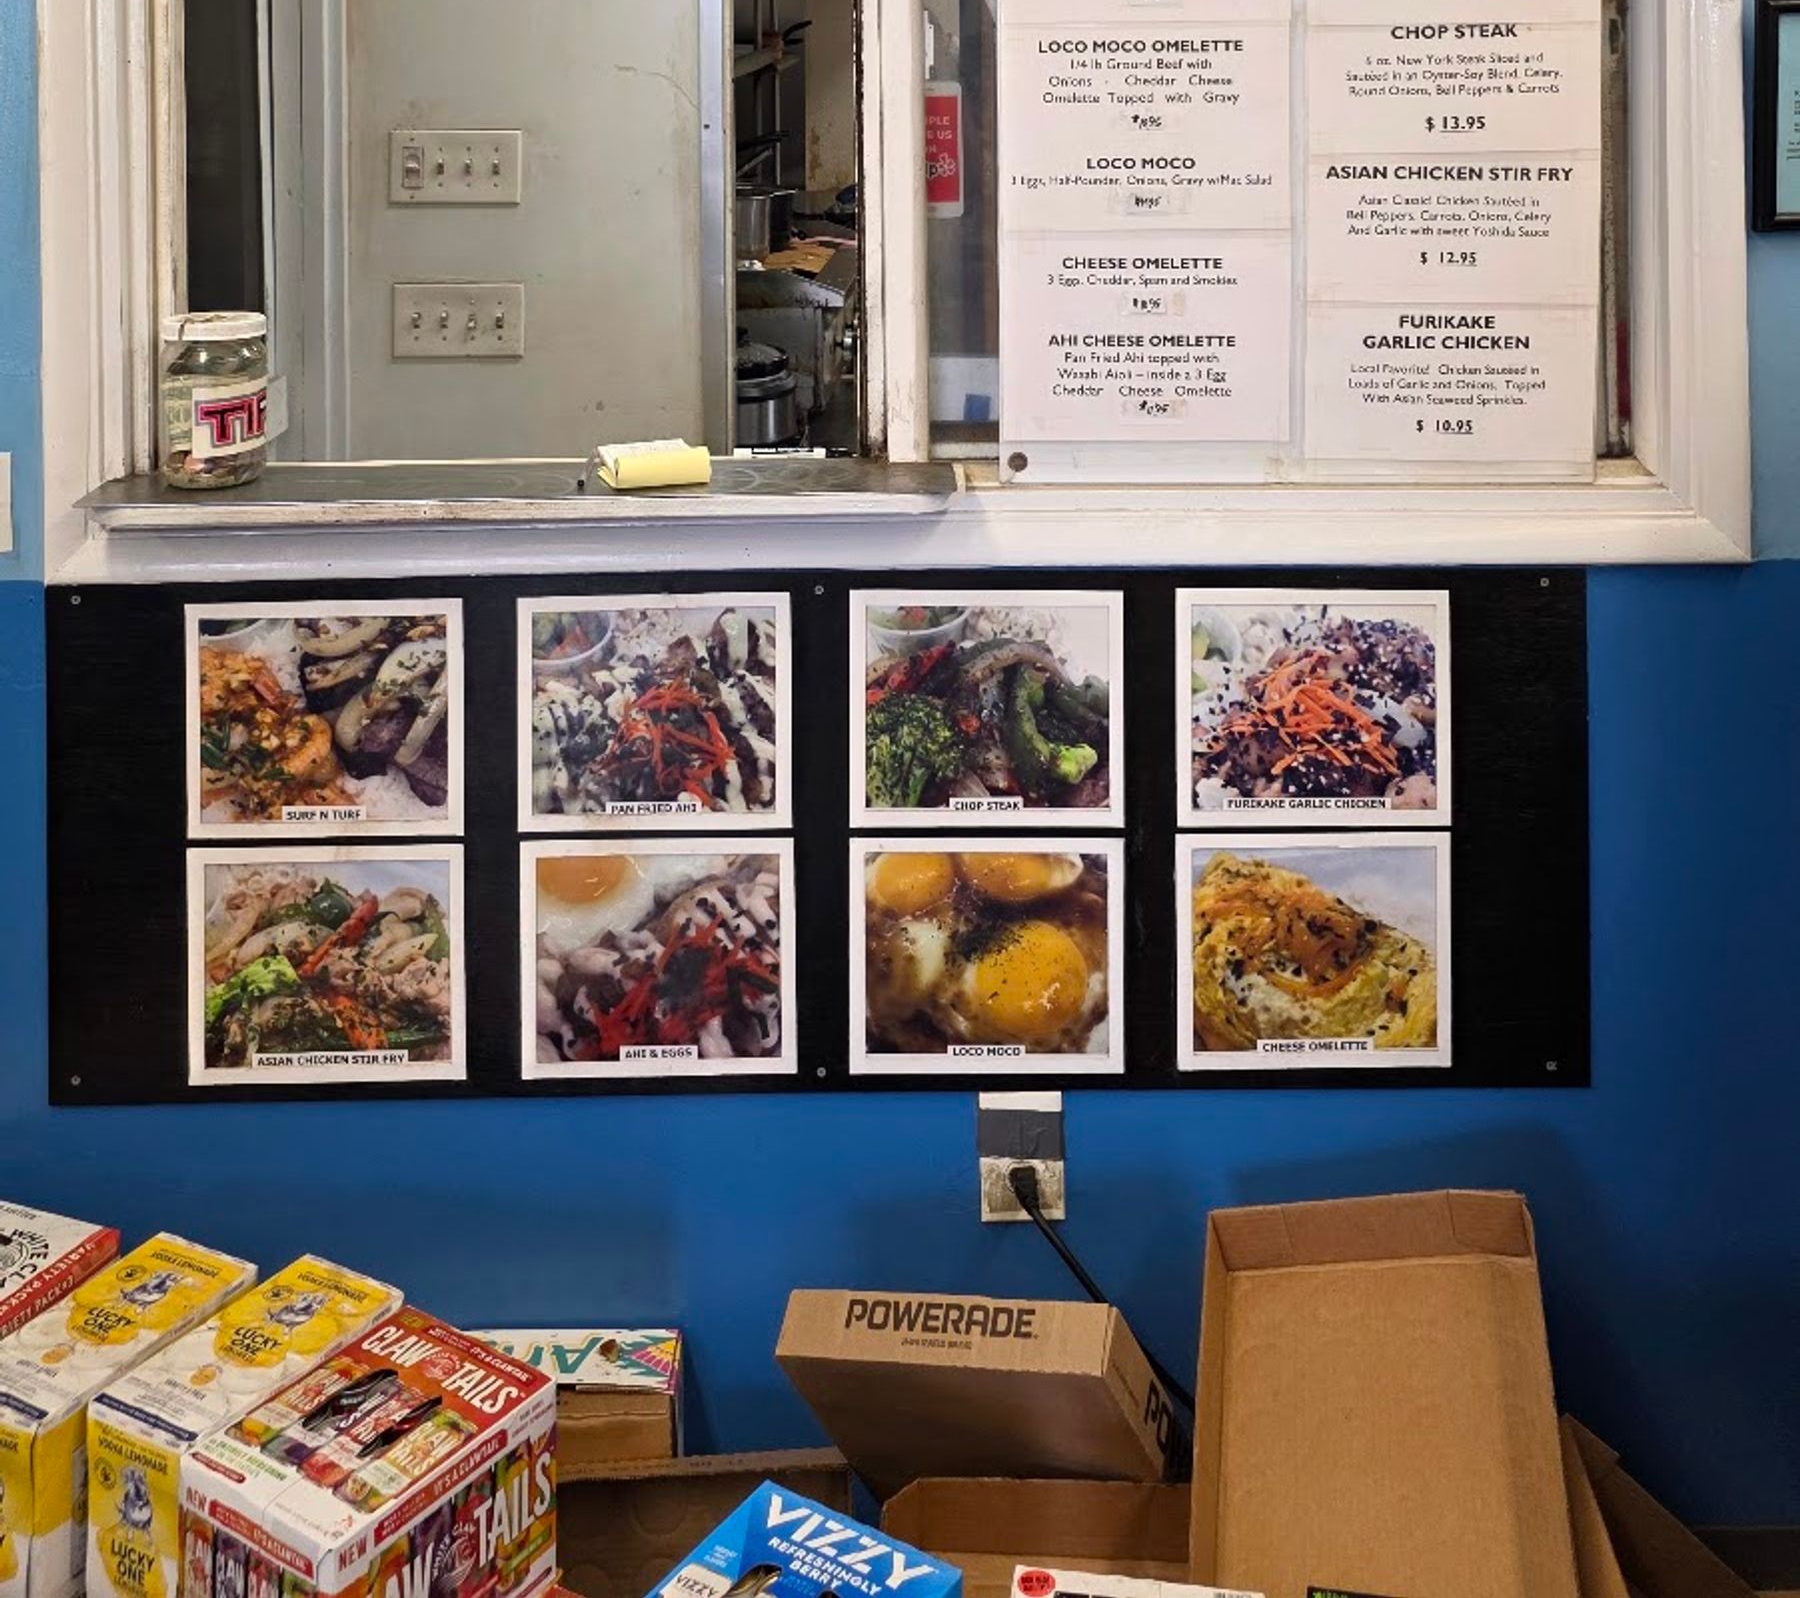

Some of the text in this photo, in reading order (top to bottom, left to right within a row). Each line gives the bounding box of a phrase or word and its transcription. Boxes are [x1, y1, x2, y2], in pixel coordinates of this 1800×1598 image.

[1391, 24, 1517, 39] CHOP STEAK
[1039, 40, 1243, 53] LOCO MOCO OMELETTE
[1157, 59, 1183, 69] Beef
[1187, 59, 1211, 69] with
[1049, 74, 1232, 87] Onions Cheddar Cheese
[1518, 83, 1559, 93] Carrots
[1107, 92, 1153, 105] Topped
[1165, 93, 1191, 103] with
[1203, 92, 1239, 105] Gravy
[1426, 116, 1485, 132] $ 13.95
[1087, 157, 1195, 169] LOCO MOCO
[1327, 166, 1573, 181] ASIAN CHICKEN STIR FRY
[1411, 226, 1433, 235] with
[1063, 257, 1222, 269] CHEESE OMELETTE
[1421, 252, 1476, 265] $ 12.95
[1171, 276, 1190, 285] and
[1400, 315, 1495, 329] FURIKAKE
[1049, 335, 1235, 347] AHI CHEESE OMELETTE
[1363, 336, 1529, 349] GARLIC CHICKEN
[1053, 384, 1231, 397] Cheddar Cheese Omelette
[1417, 420, 1472, 433] $ 10.95
[611, 803, 697, 815] PAN FRIED AHI
[954, 801, 1020, 811] CHOP STEAK
[1228, 799, 1386, 809] FURIKAKE GARLIC CHICKEN
[319, 810, 329, 821] N
[332, 809, 361, 821] TURF
[625, 1047, 693, 1059] AHI & EGGS
[953, 1047, 1021, 1056] LOCO MOCO
[1262, 1041, 1368, 1053] CHEESE OMELETTE
[257, 1053, 405, 1067] ASIAN CHICKEN STIR FRY
[87, 1306, 137, 1328] LUCKY
[844, 1298, 1037, 1340] POWERADE
[84, 1317, 119, 1335] ONE
[234, 1326, 283, 1351] LUCKY
[231, 1338, 263, 1356] ONE
[361, 1325, 444, 1368] CLAW
[440, 1361, 519, 1414] TAILS
[473, 1451, 551, 1569] TAILS
[766, 1493, 936, 1590] VIZZY
[111, 1538, 156, 1574] LUCKY
[338, 1534, 369, 1572] NEW
[116, 1559, 146, 1586] ONE
[767, 1535, 882, 1597] REFRESHINGLY
[788, 1558, 843, 1590] BERRY
